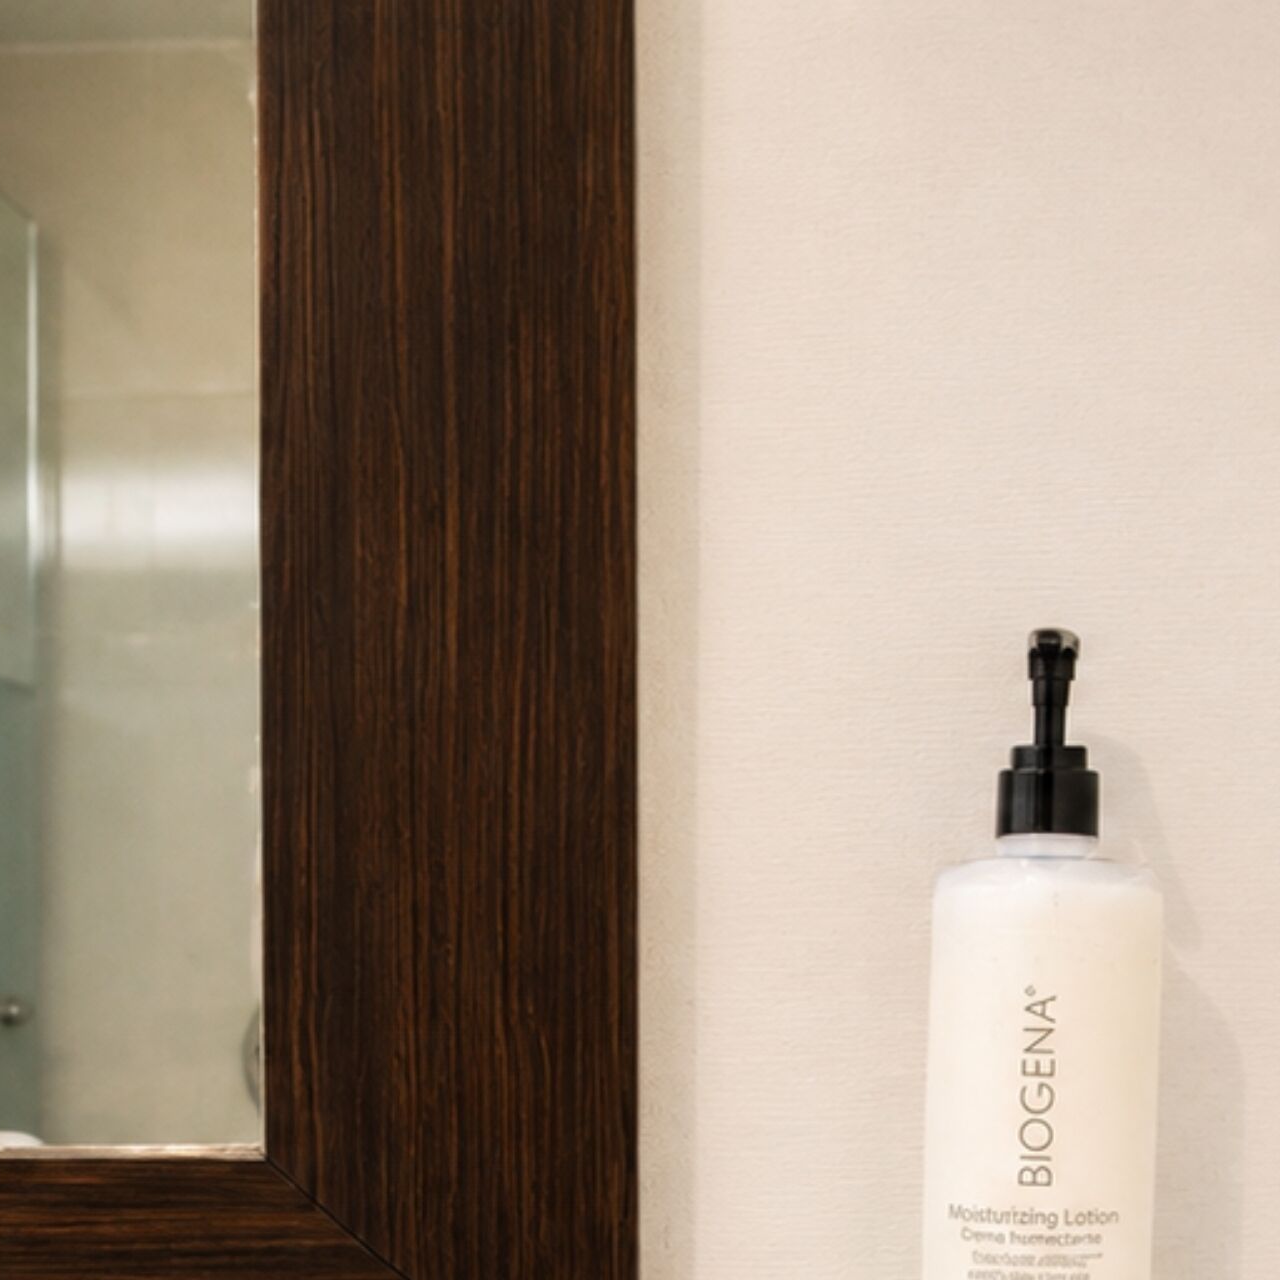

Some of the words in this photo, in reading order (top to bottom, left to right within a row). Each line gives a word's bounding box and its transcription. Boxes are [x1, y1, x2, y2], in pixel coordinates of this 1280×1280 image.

[1017, 993, 1057, 1188] BIOGENA
[947, 1203, 1060, 1230] Moisturizing
[1063, 1208, 1121, 1227] Lotion
